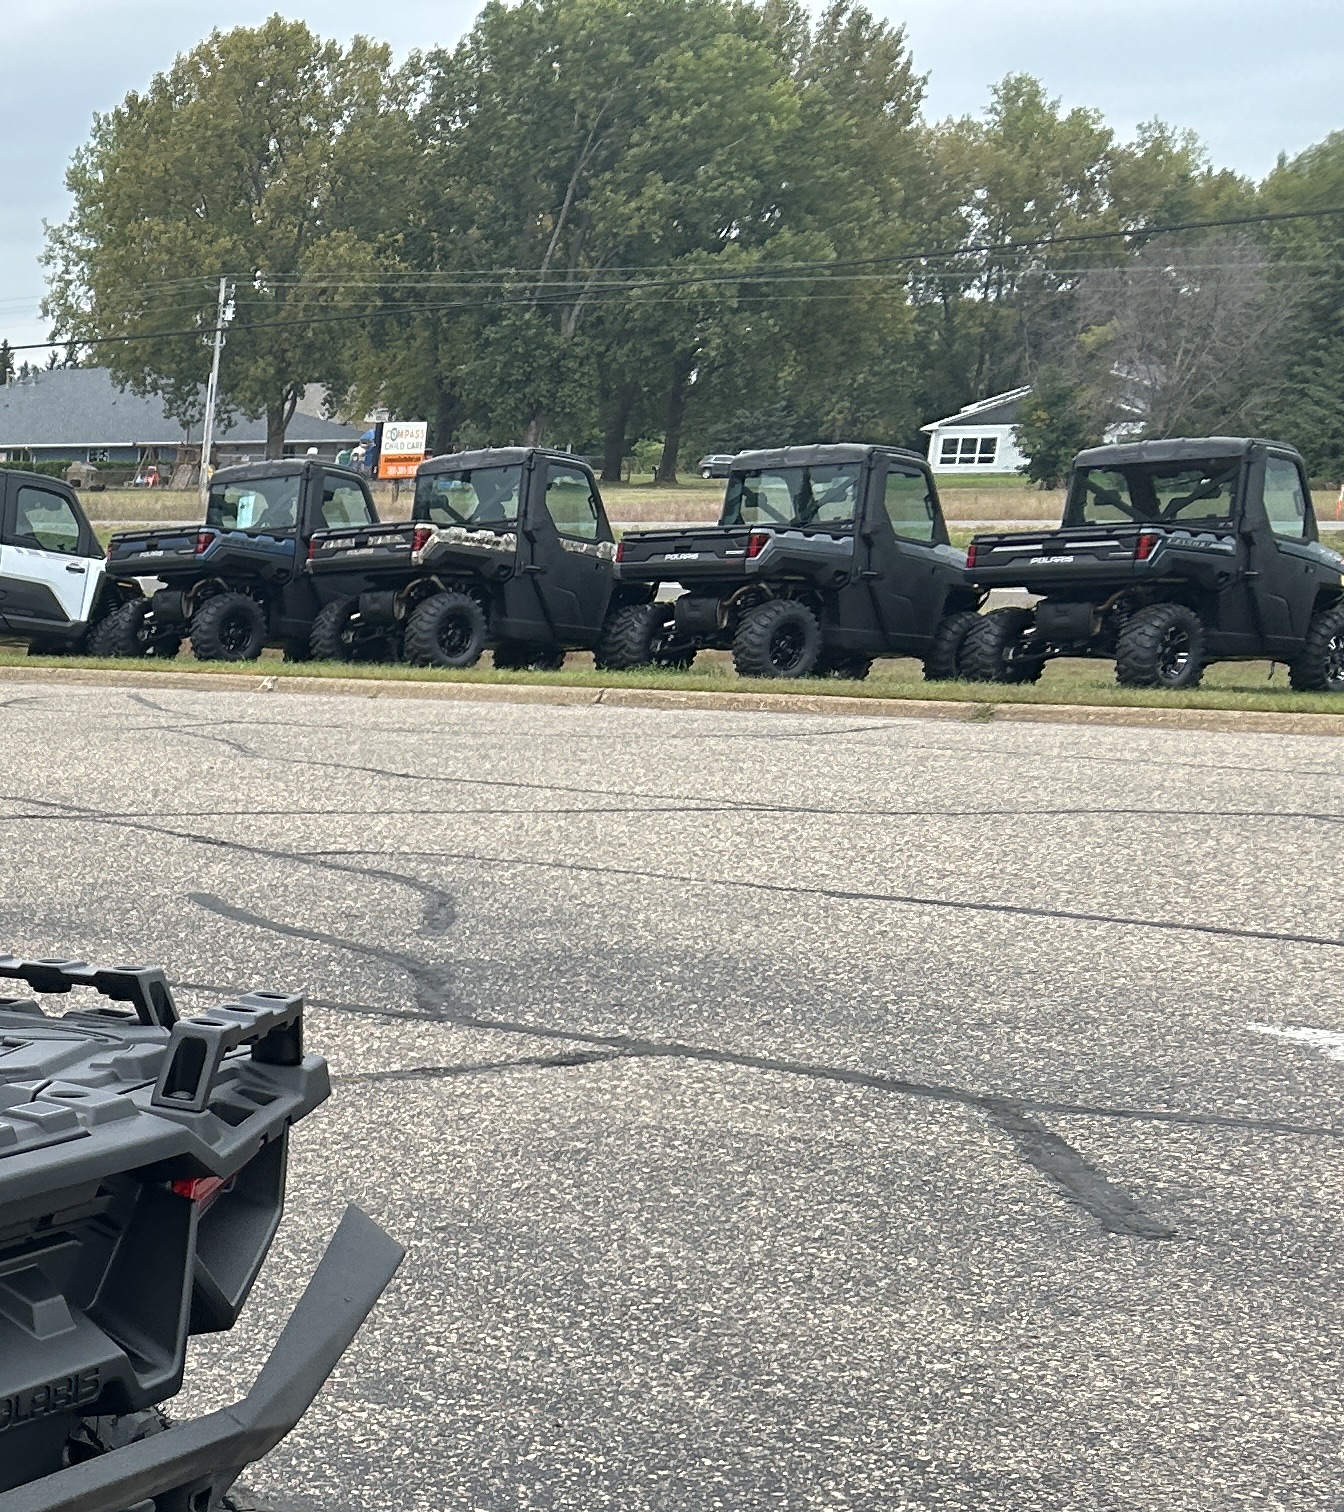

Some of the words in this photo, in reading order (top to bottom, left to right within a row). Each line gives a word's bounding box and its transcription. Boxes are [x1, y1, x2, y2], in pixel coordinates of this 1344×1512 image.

[385, 427, 425, 442] COMPASS
[384, 442, 405, 450] CHILD
[407, 442, 424, 450] CARE
[664, 552, 700, 561] POLARIS
[1029, 555, 1075, 564] POLARIS
